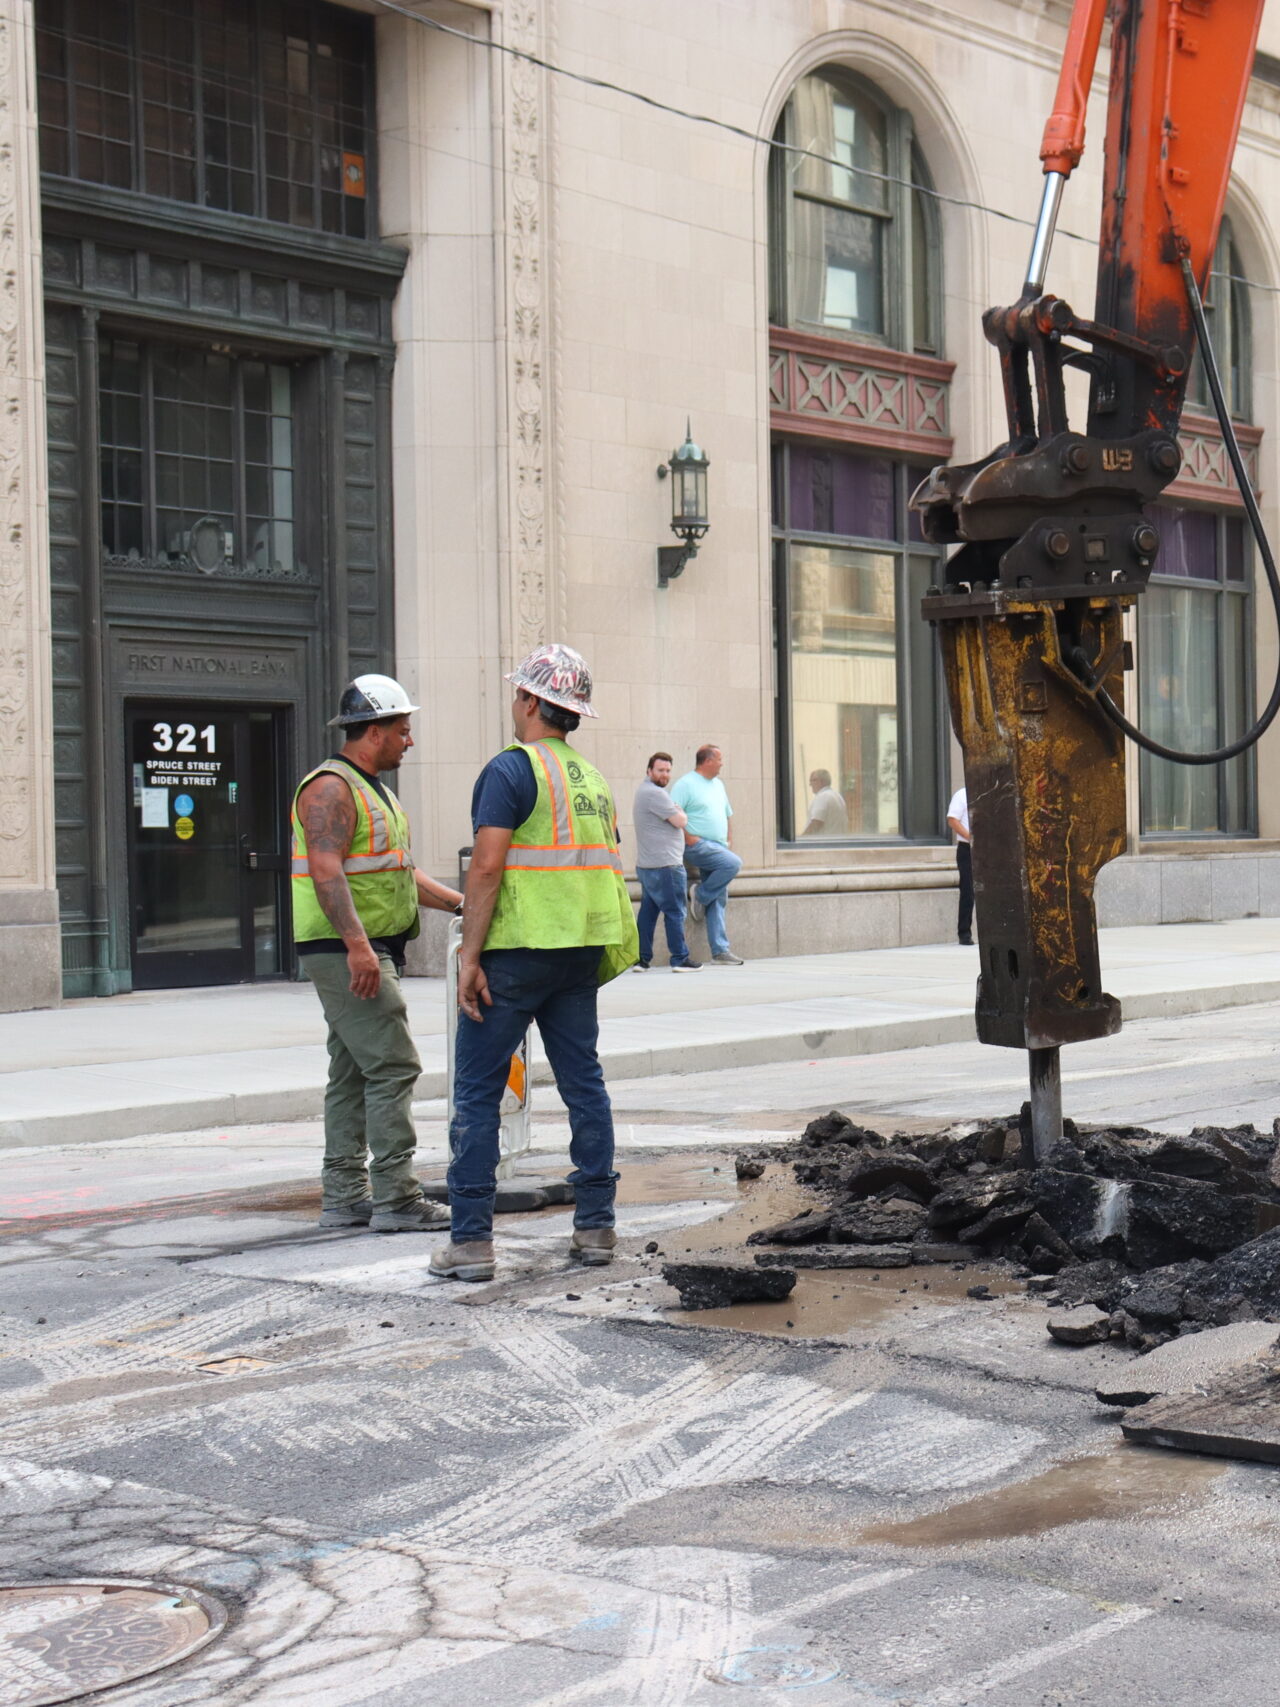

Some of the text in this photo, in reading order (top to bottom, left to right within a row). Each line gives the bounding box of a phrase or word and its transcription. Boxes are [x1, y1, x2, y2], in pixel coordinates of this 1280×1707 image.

[127, 653, 288, 677] FIRST NATIONAL BANK
[152, 722, 216, 754] 321
[146, 760, 222, 772] SPRUCE STREET
[150, 775, 218, 787] BIDEN STREET
